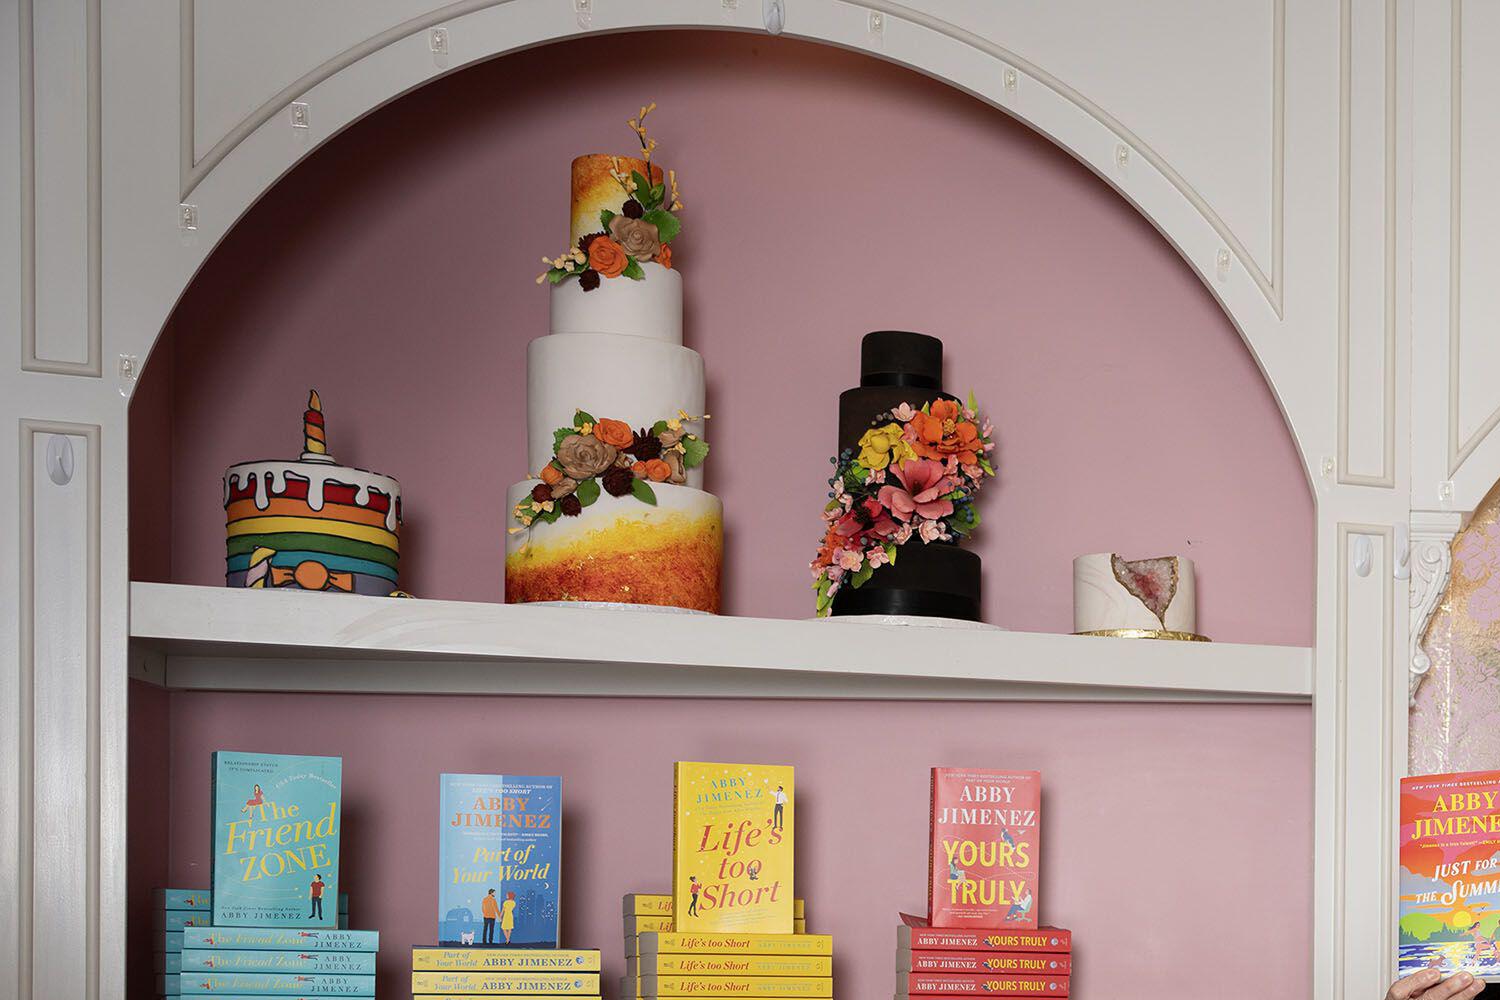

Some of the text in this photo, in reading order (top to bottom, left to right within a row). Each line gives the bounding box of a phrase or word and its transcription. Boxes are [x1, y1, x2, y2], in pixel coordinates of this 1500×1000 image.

[711, 777, 745, 789] ABBY
[696, 789, 763, 803] JIMENEZ
[960, 785, 1016, 803] ABBY
[1433, 791, 1499, 813] ABBY
[257, 801, 300, 822] The
[473, 796, 529, 811] ABBY
[451, 813, 552, 829] JIMENEZ
[938, 808, 1036, 826] JIMENEZ
[224, 802, 337, 855] Friend
[696, 819, 783, 856] Life's
[472, 844, 536, 865] Part of
[943, 840, 1030, 868] YOURS
[240, 844, 332, 881] ZONE
[718, 858, 762, 880] too
[1432, 858, 1498, 882] JUST FOR
[452, 863, 551, 884] Your World
[698, 881, 782, 911] Short
[947, 879, 1026, 905] TRULY
[1416, 891, 1437, 904] THE
[314, 941, 362, 949] JIMENEZ
[708, 939, 723, 947] too
[724, 938, 750, 948] Short
[940, 938, 978, 946] JIMENEZ
[988, 936, 1019, 946] YOURS
[1020, 936, 1048, 946] TRULY
[462, 952, 471, 960] of
[483, 958, 573, 966] ABBY JIMENEZ
[916, 960, 938, 968] ABBY
[987, 958, 1018, 968] YOURS
[1019, 959, 1047, 969] TRULY
[707, 961, 722, 970] too
[723, 961, 749, 970] Short
[481, 982, 571, 990] ABBY JIMENEZ
[707, 983, 722, 991] too
[724, 982, 750, 991] Short
[939, 983, 976, 991] JIMENEZ
[987, 981, 1017, 991] YOURS
[1018, 981, 1046, 991] TRULY
